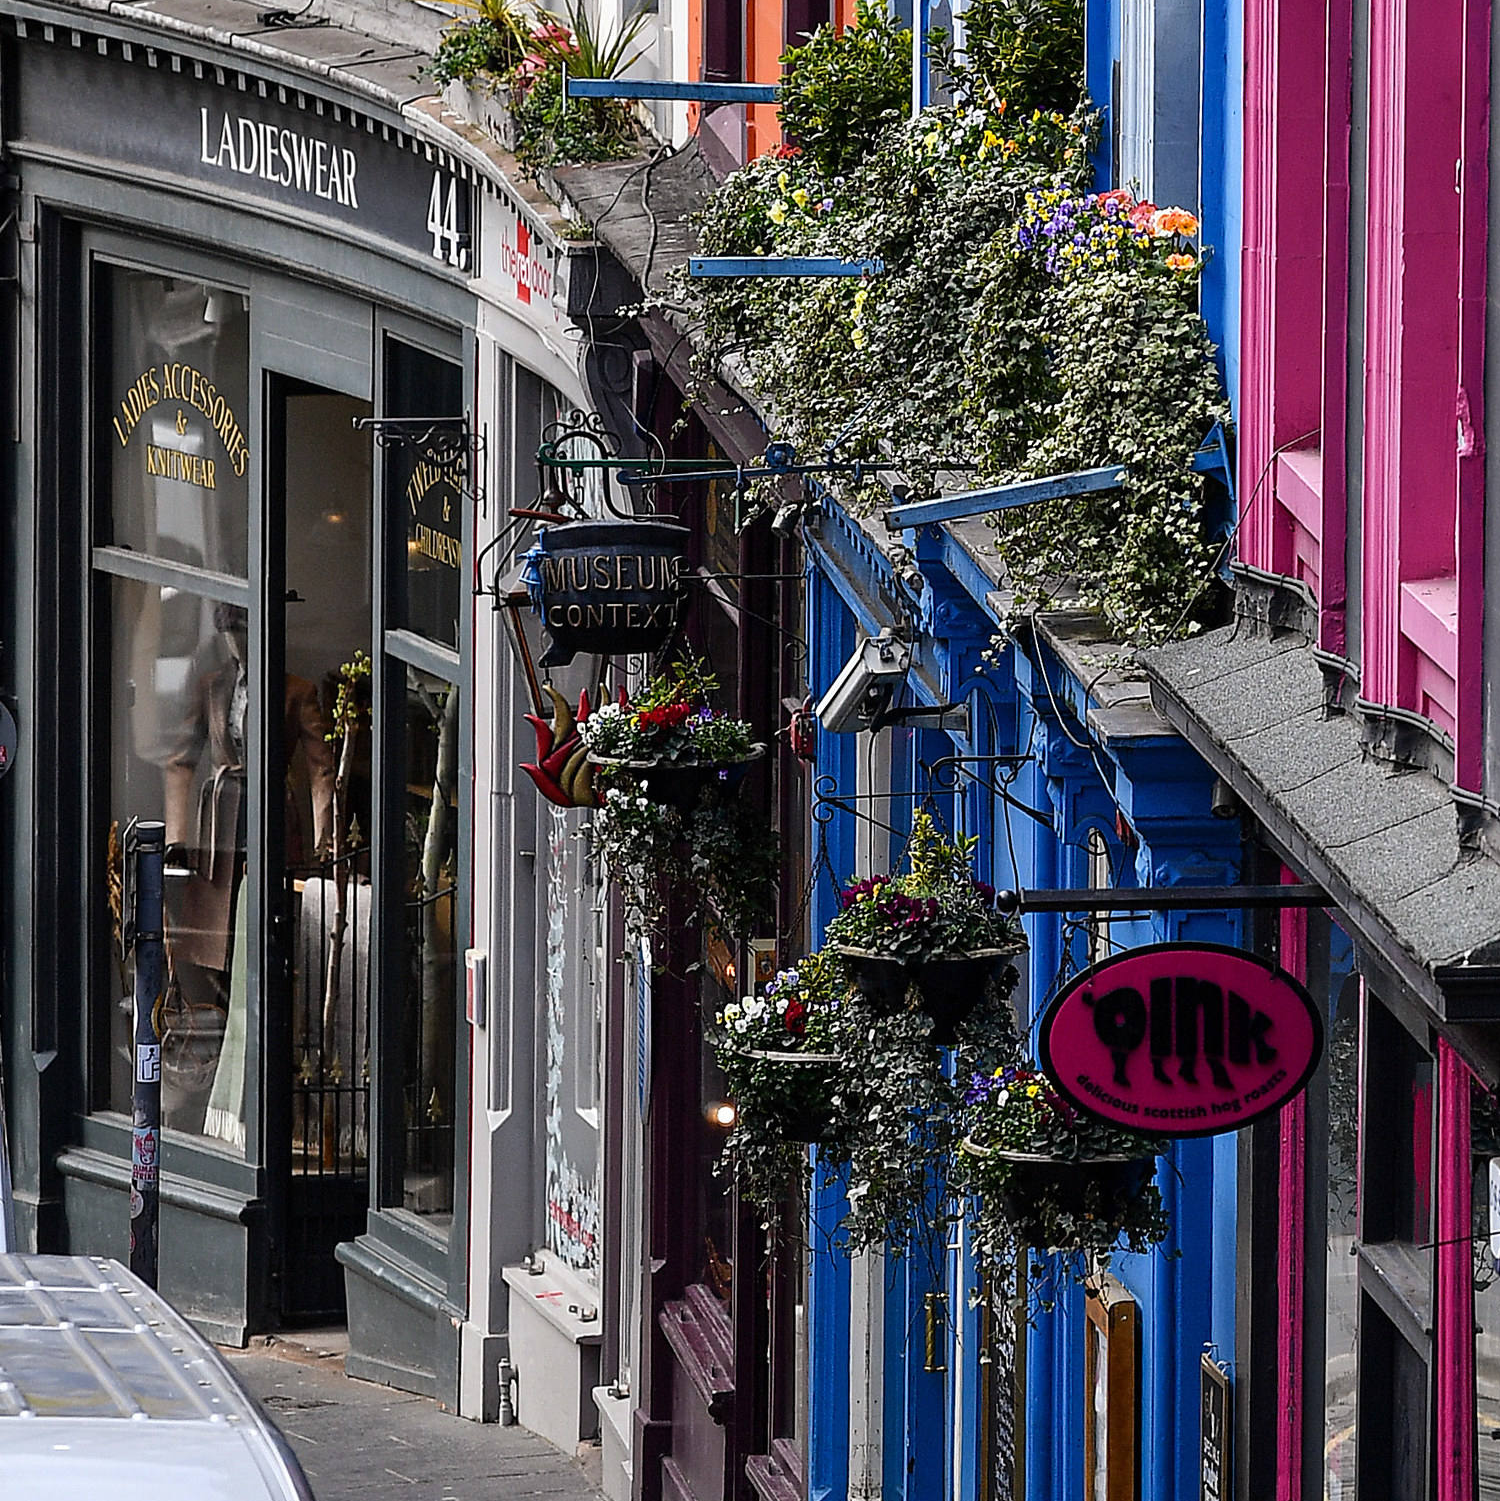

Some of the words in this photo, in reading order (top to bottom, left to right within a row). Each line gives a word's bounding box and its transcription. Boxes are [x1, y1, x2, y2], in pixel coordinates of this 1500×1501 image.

[200, 107, 358, 209] LADIESWEAR
[113, 367, 159, 447] LADIES
[163, 363, 249, 477] ACCESSORIES
[175, 409, 187, 436] &
[147, 445, 216, 489] KNITWEAR
[545, 555, 680, 594] MUSEUM
[549, 603, 678, 629] CONTEXT
[1077, 1072, 1140, 1116] delicious
[1143, 1102, 1207, 1120] scottish
[1211, 1097, 1243, 1114] hog
[1243, 1067, 1288, 1104] roasts
